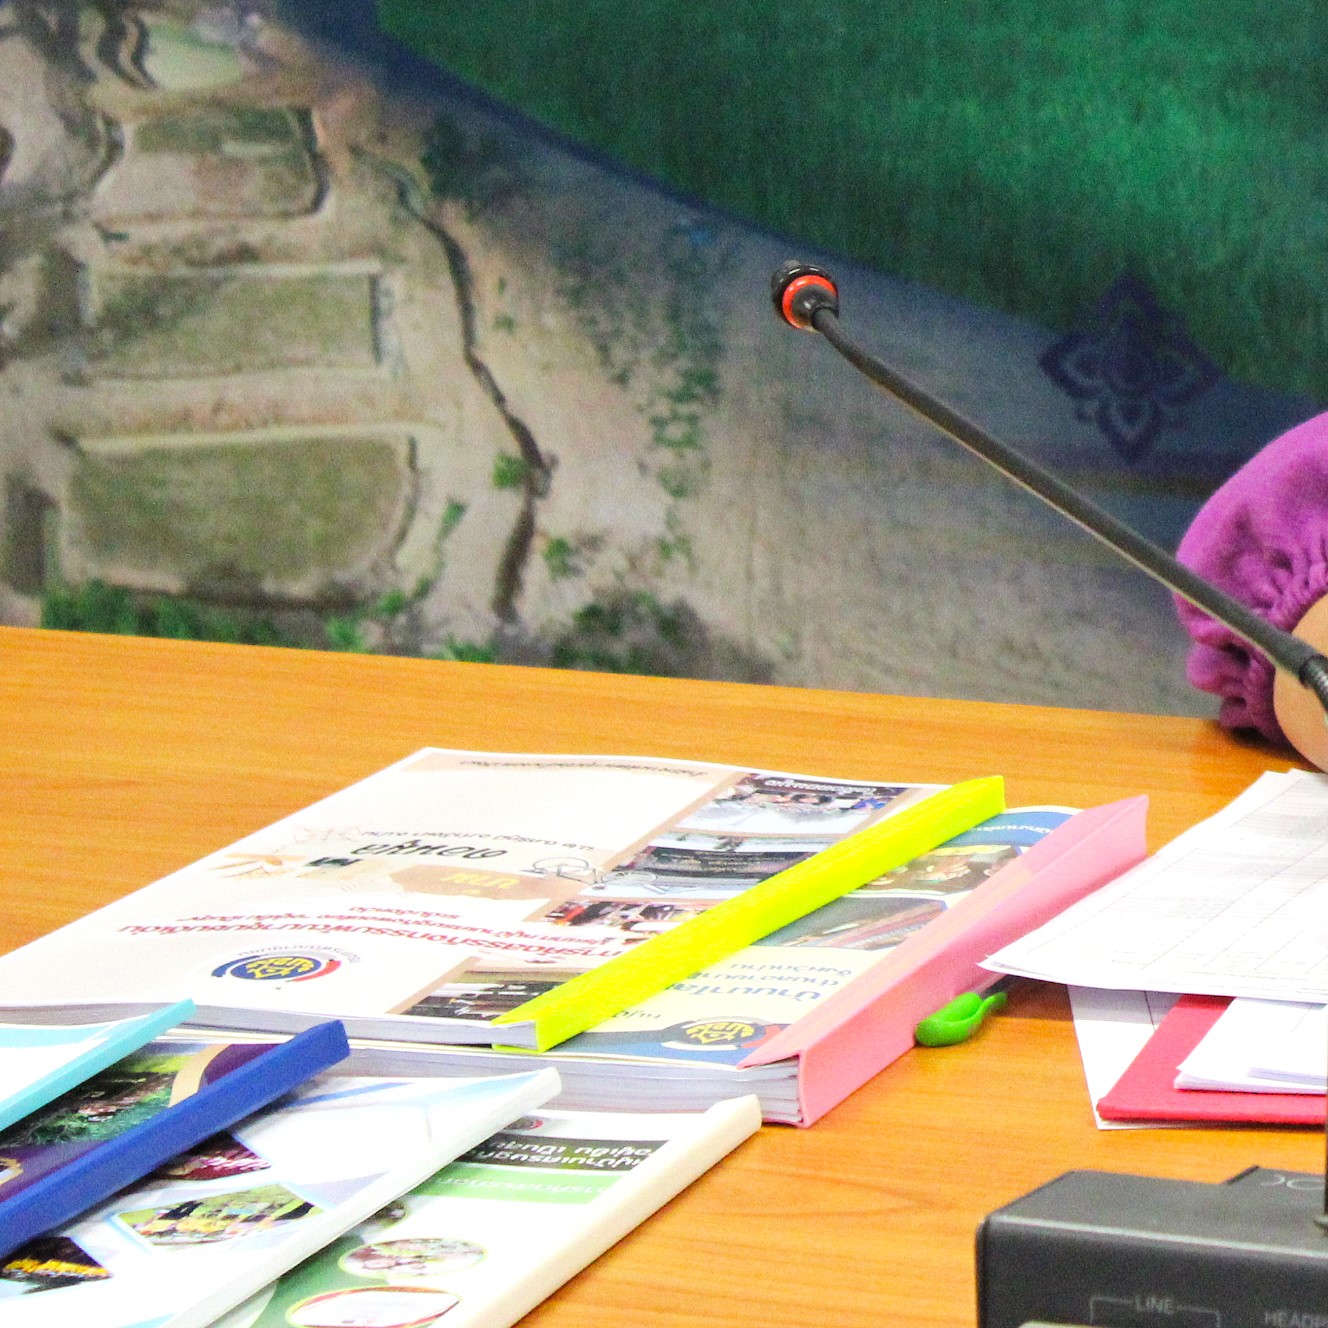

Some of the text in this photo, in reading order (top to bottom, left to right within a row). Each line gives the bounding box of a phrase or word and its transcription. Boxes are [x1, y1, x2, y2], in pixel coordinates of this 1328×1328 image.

[729, 962, 852, 976] จังหวัดน่าน
